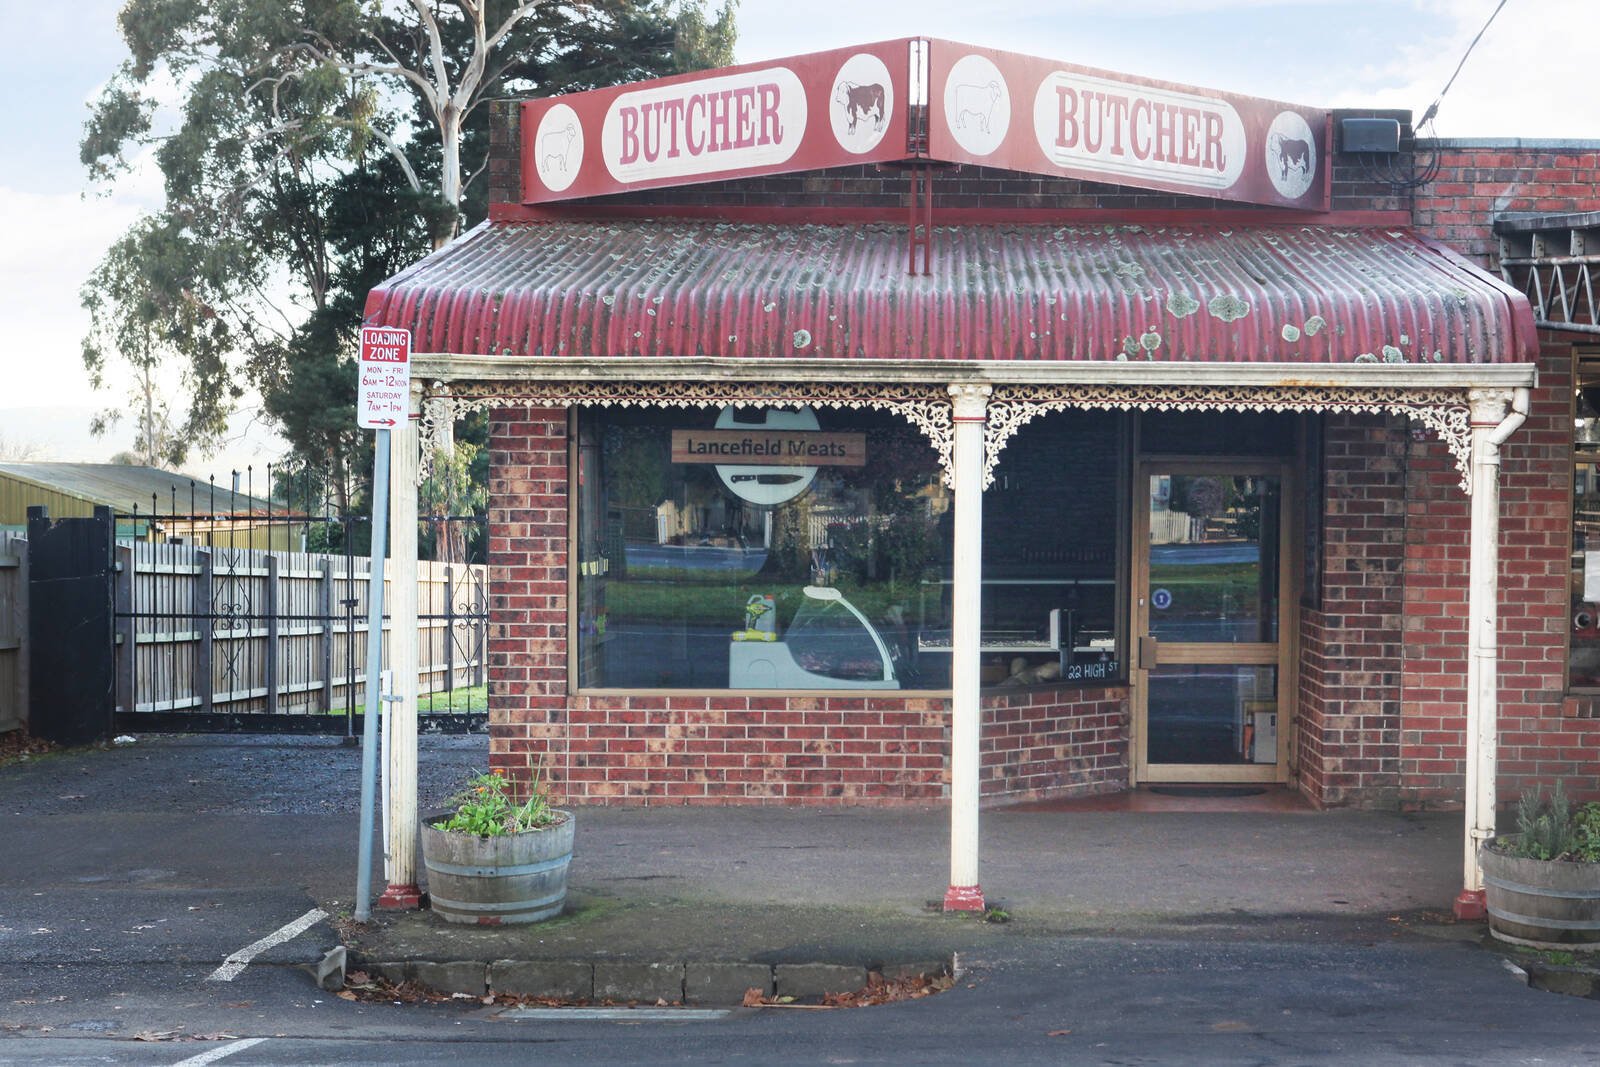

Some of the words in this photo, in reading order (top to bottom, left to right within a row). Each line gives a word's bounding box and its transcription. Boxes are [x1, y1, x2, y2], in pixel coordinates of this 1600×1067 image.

[619, 82, 784, 166] BUTCHER
[1054, 85, 1228, 174] BUTCHER
[364, 332, 406, 346] LOADING
[369, 347, 400, 360] ZONE
[366, 366, 382, 374] MON
[366, 391, 402, 399] SATURDAY
[687, 438, 782, 457] Lancefield
[787, 440, 846, 458] Meats
[1068, 665, 1081, 679] 22
[1084, 663, 1105, 678] HIGH
[1108, 662, 1118, 671] ST
